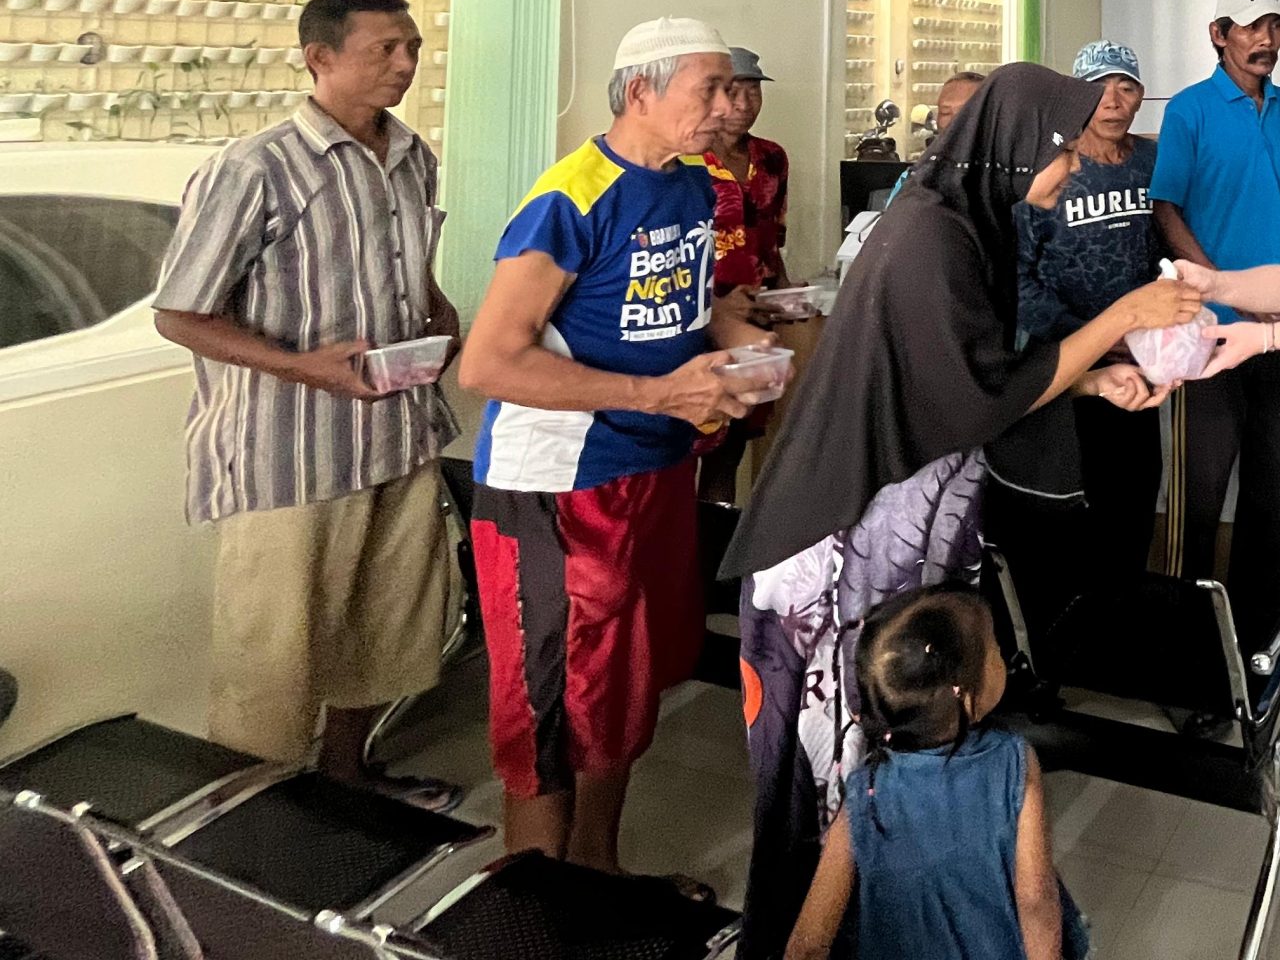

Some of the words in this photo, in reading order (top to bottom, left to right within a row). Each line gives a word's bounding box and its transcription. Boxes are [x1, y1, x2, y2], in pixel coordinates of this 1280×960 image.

[1065, 187, 1153, 222] HURLE
[630, 238, 695, 277] Beach
[625, 267, 692, 304] Night
[620, 302, 682, 328] Run
